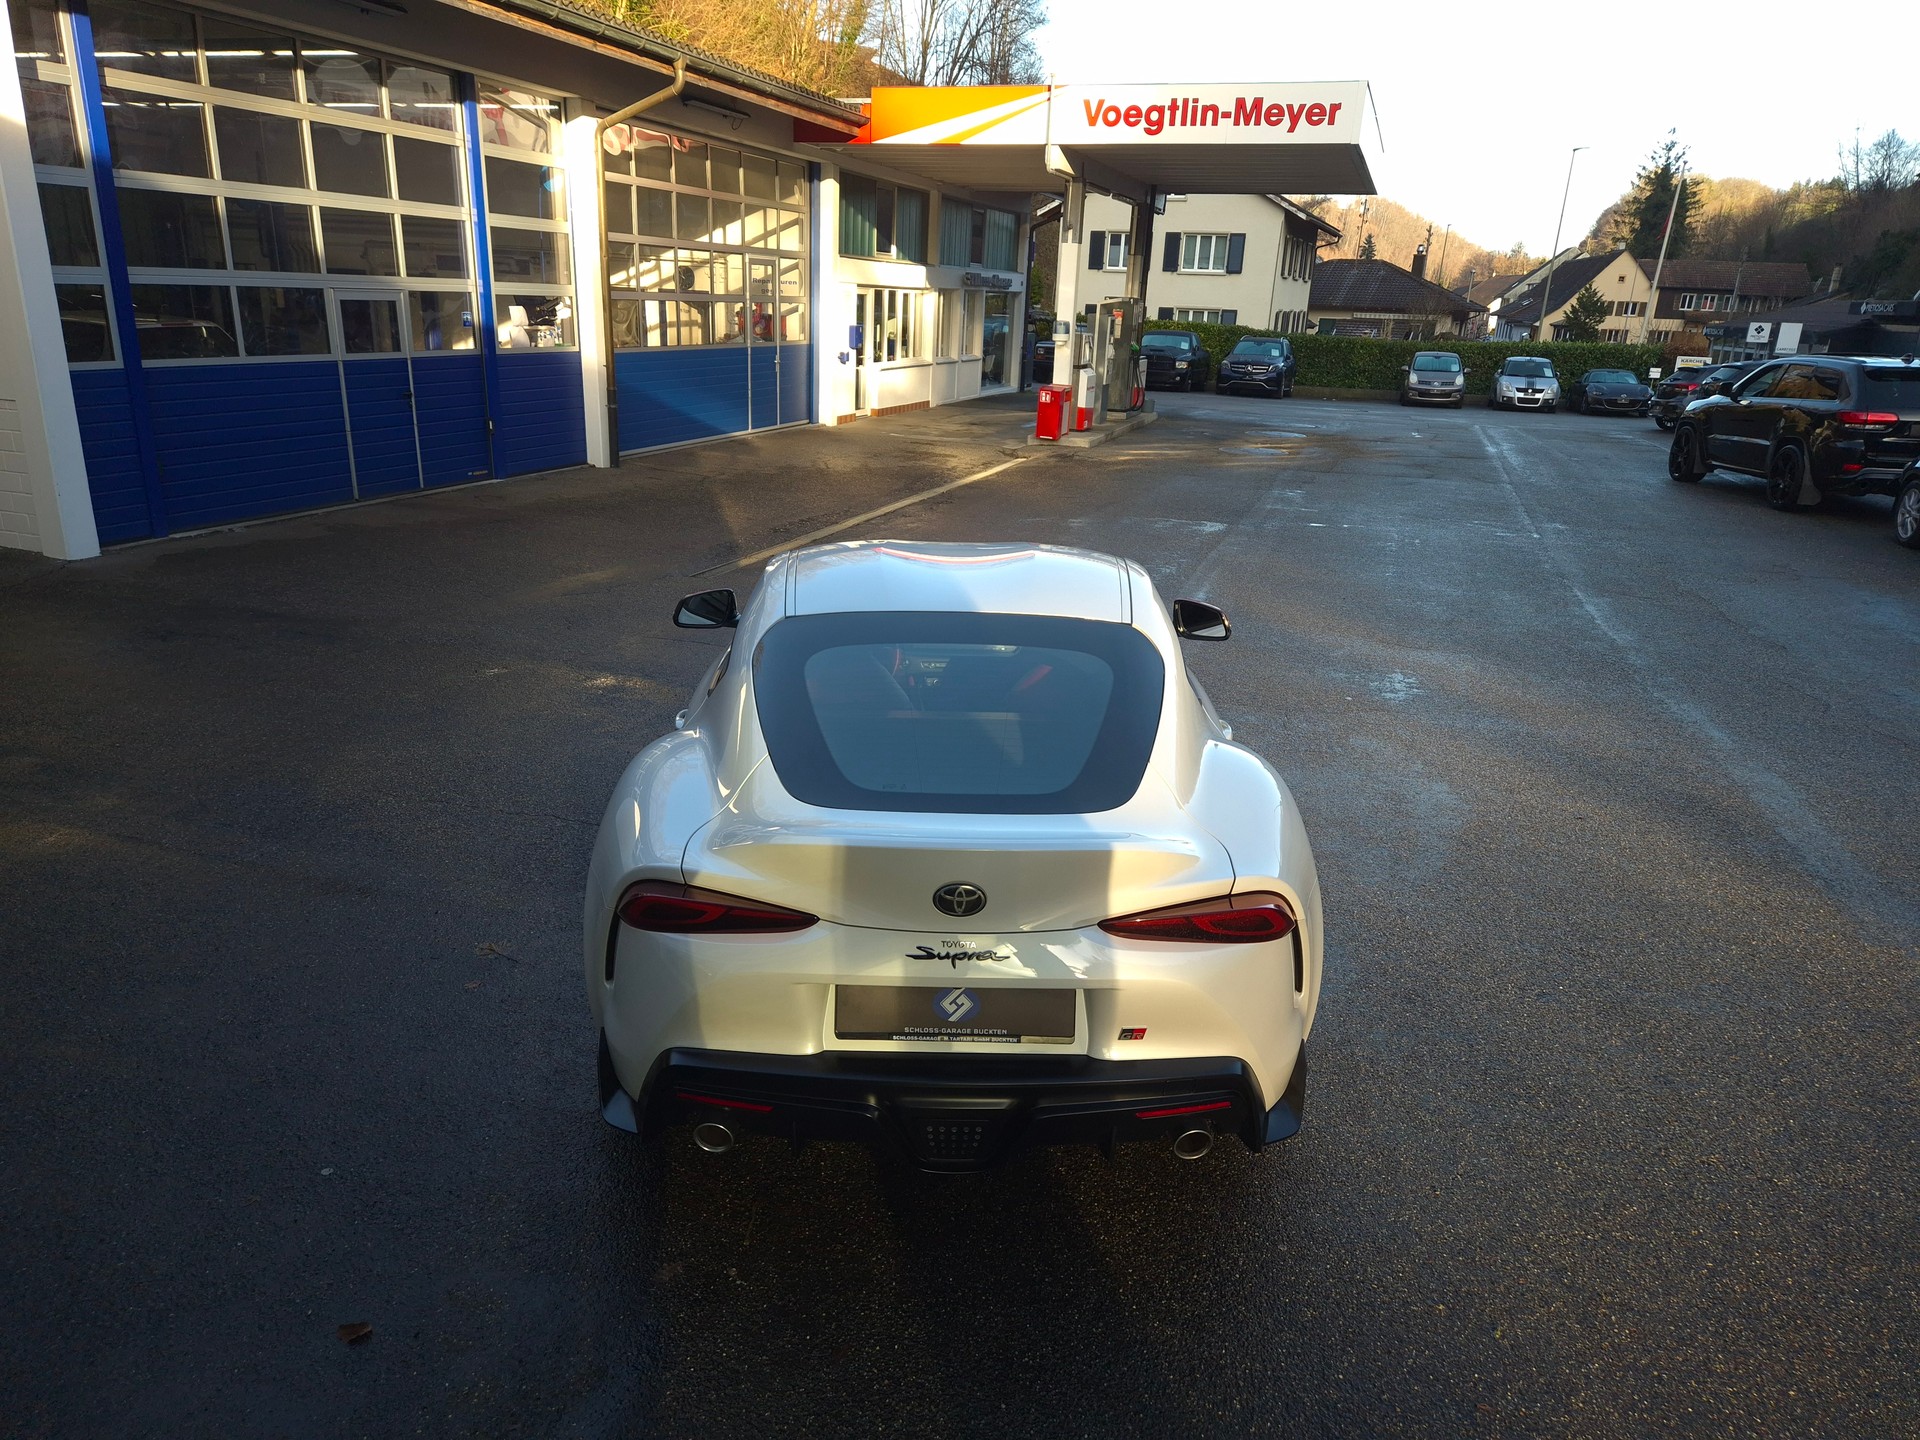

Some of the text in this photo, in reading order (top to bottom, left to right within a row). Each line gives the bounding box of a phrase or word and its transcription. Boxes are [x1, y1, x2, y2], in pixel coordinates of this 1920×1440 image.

[1083, 97, 1342, 135] Voegtlin-Meyer
[941, 940, 977, 949] TOYOTA
[905, 945, 1010, 970] Supra
[904, 1026, 972, 1035] SCHLOSS-GARAGE
[1119, 1031, 1145, 1041] GR
